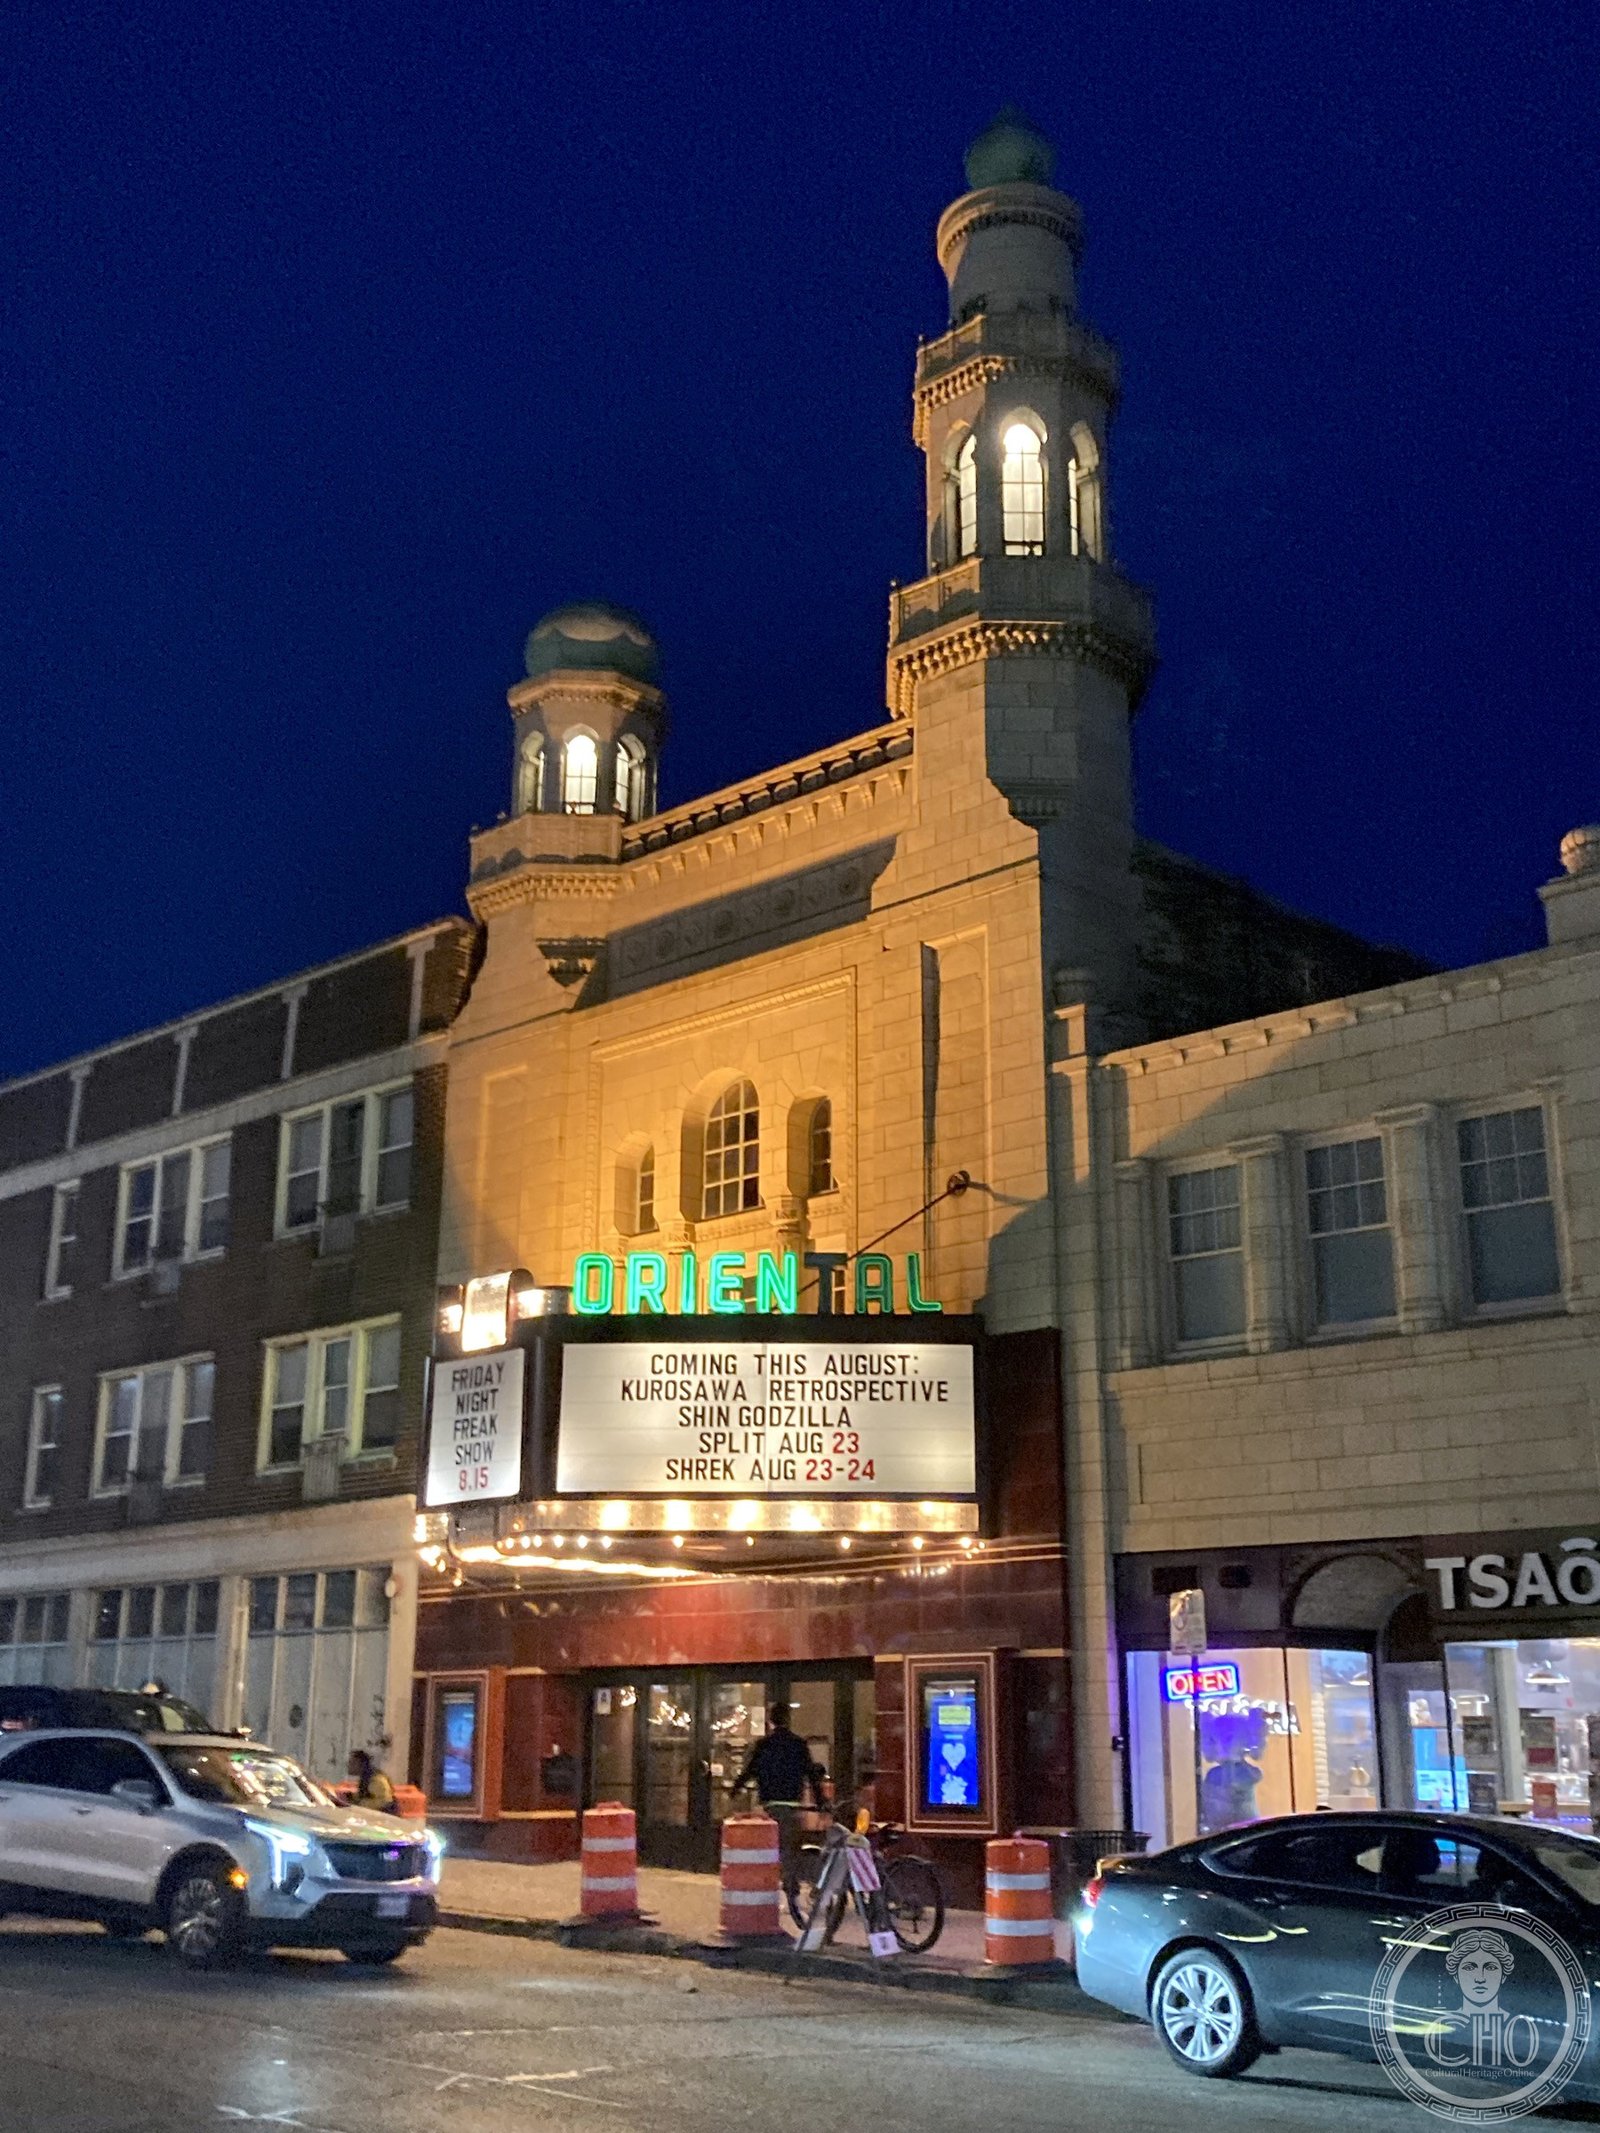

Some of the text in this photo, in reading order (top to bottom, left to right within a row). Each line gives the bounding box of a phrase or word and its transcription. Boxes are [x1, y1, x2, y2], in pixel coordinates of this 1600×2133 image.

[574, 1251, 943, 1315] ORIENTAL
[451, 1361, 505, 1391] FRIDAY
[651, 1354, 919, 1375] COMING THIS AUGUST:
[456, 1388, 499, 1415] NIGHT
[621, 1380, 949, 1402] KUROSAWA RETROSPECTIVE
[453, 1414, 498, 1441] FREAK
[679, 1406, 852, 1427] SHIN GODZILLA
[455, 1441, 494, 1465] SHOW
[699, 1432, 860, 1454] SPLIT AUG 23
[459, 1467, 489, 1491] 8.15
[666, 1458, 876, 1481] SHREK AUG 23-24
